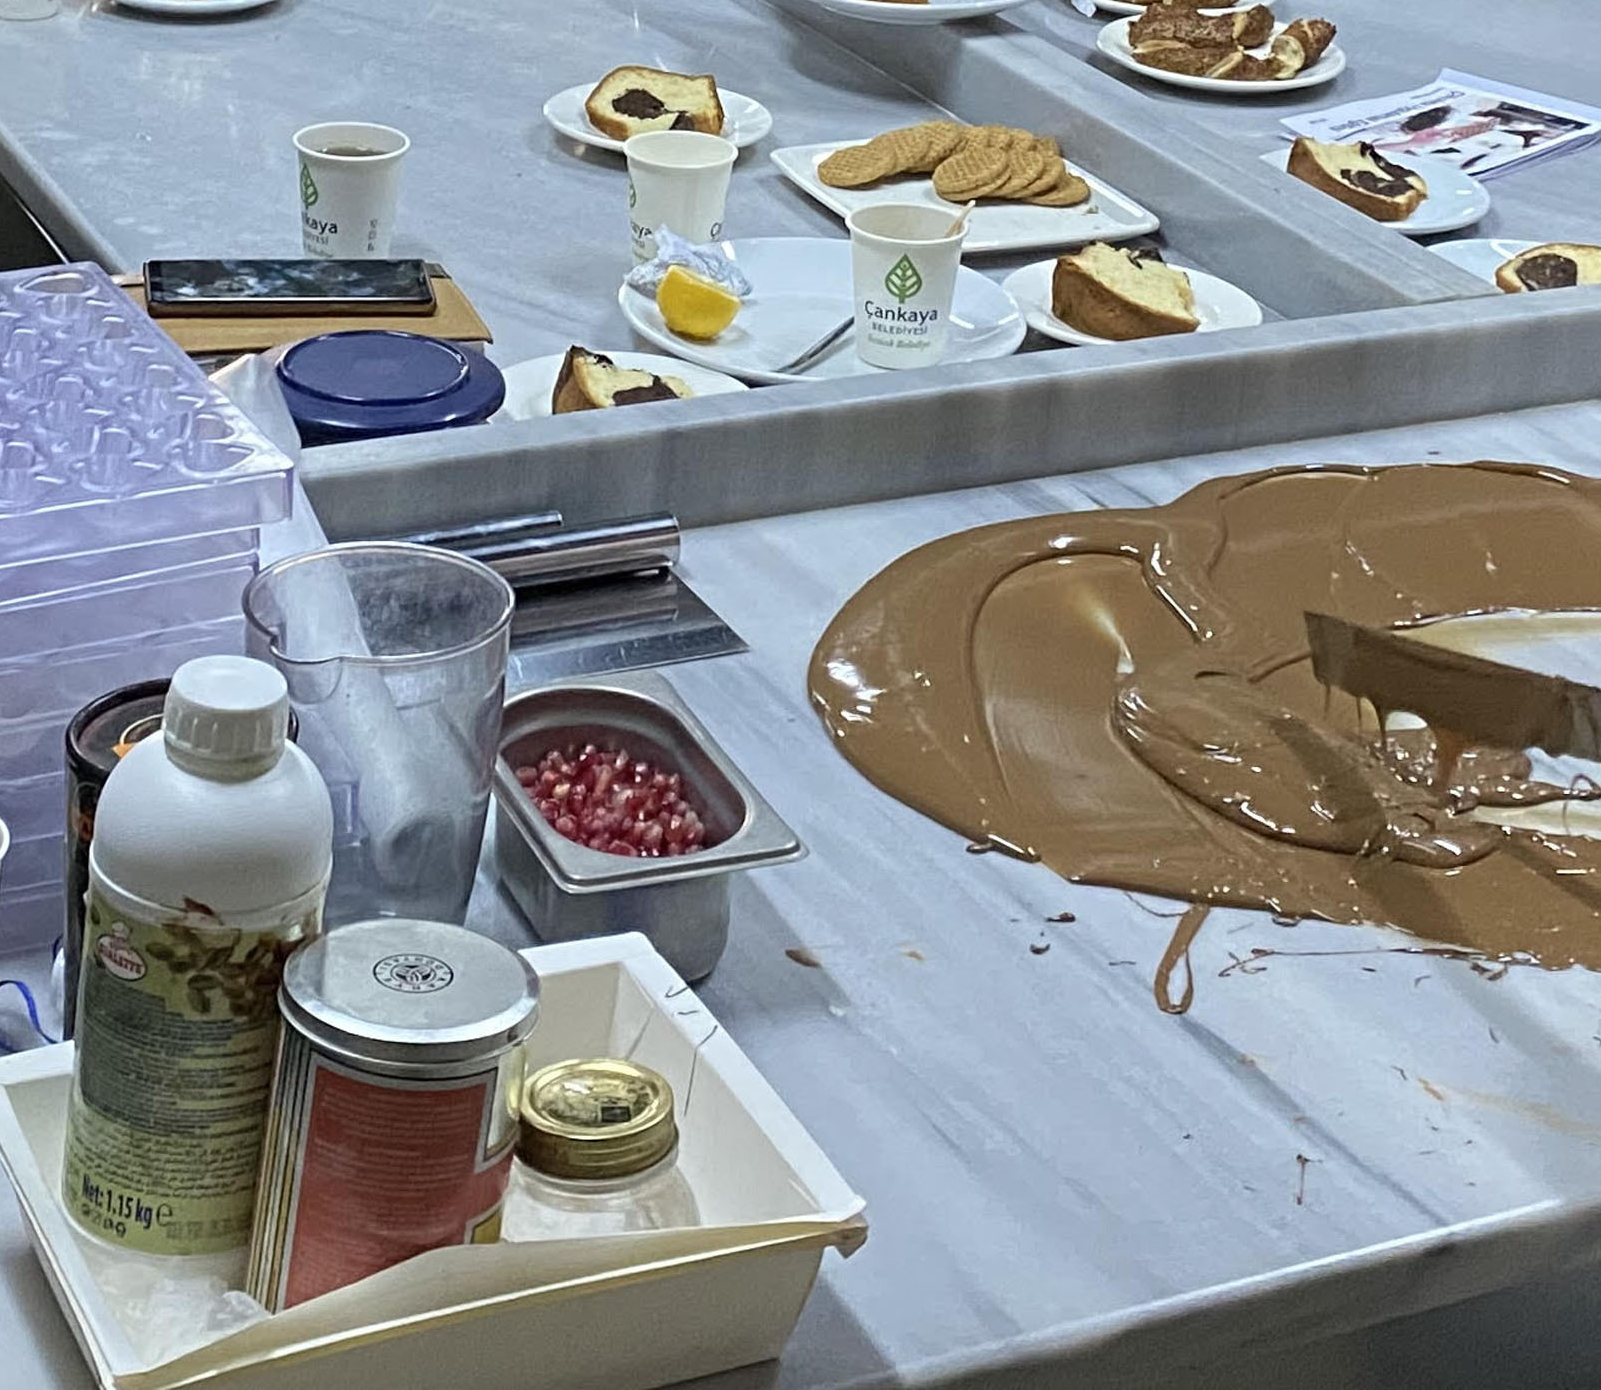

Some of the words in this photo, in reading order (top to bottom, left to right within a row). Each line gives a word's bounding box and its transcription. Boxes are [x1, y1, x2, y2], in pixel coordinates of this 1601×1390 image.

[865, 300, 938, 326] Çankaya
[82, 1172, 103, 1207] Net:
[107, 1189, 134, 1219] 1.15
[135, 1197, 154, 1230] kg
